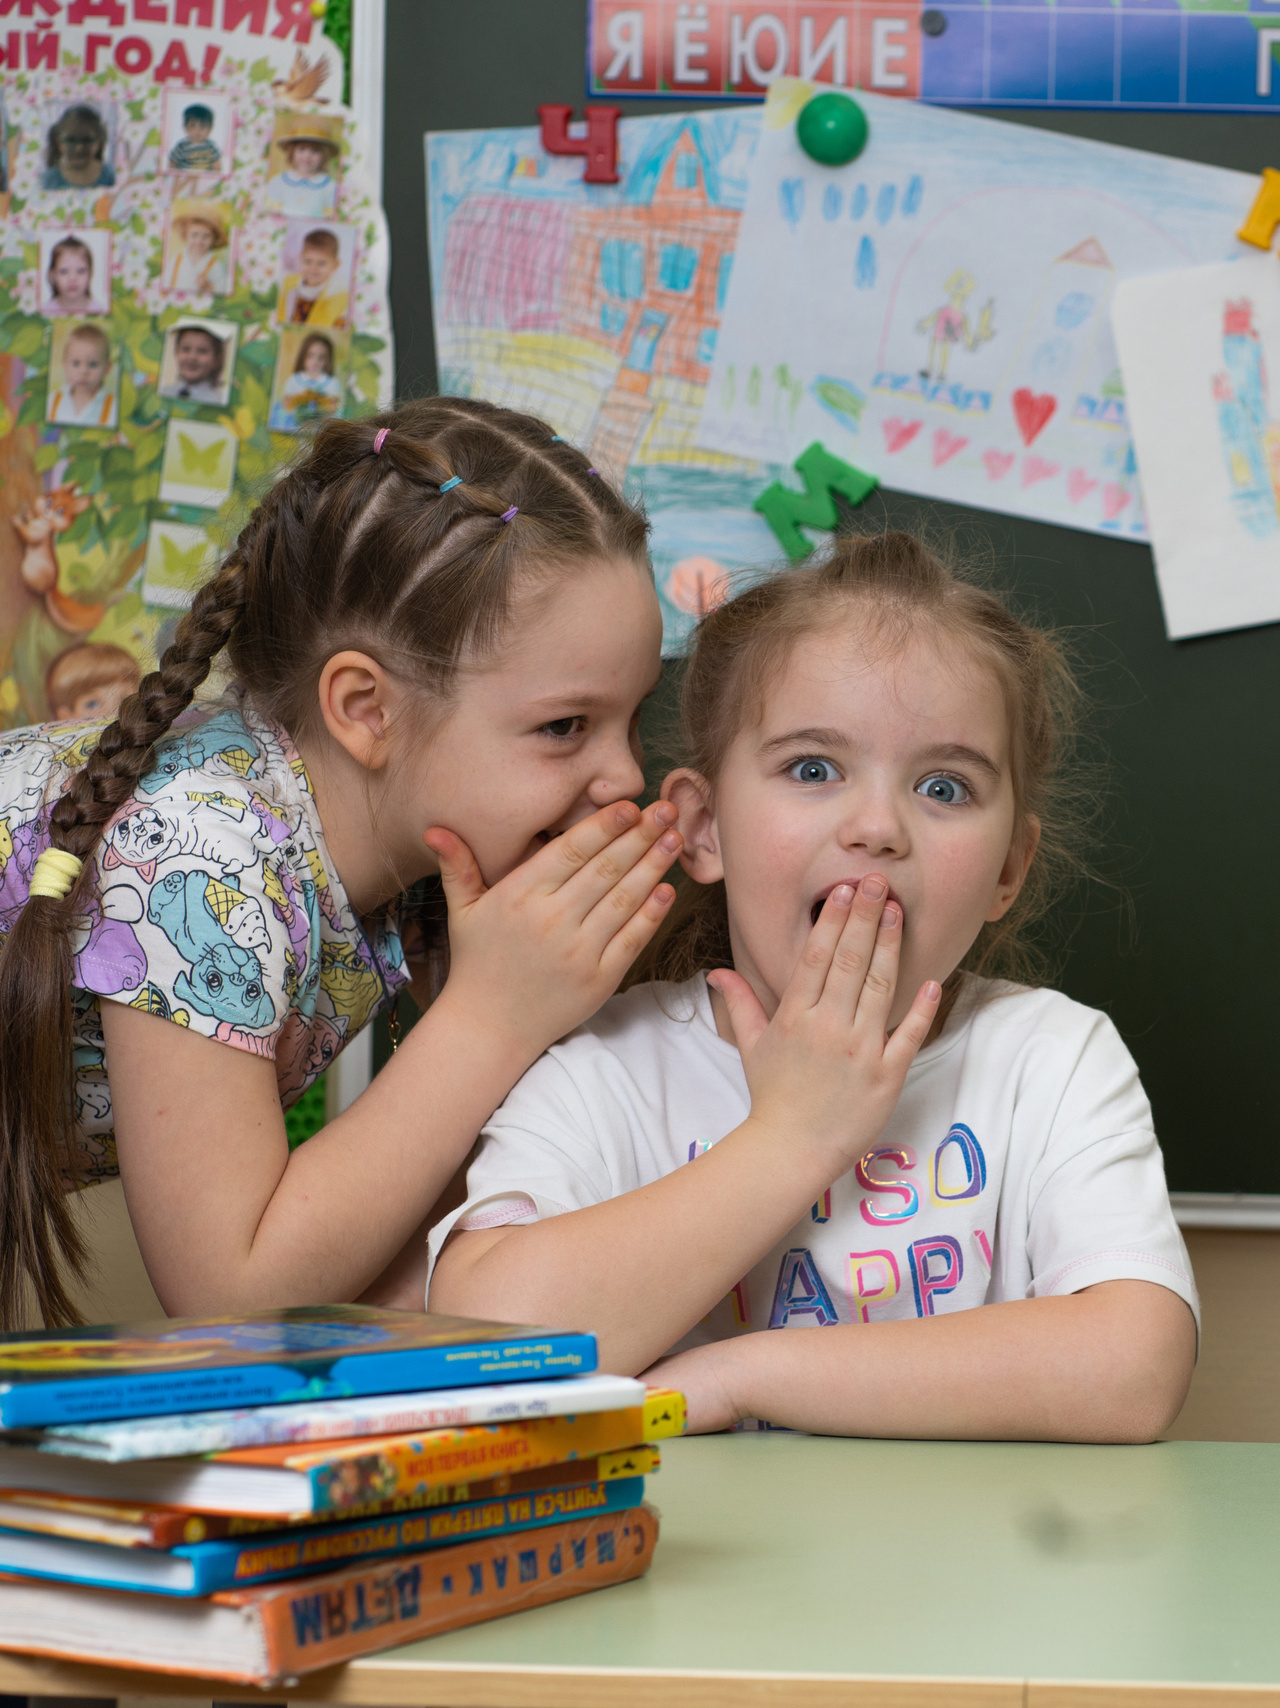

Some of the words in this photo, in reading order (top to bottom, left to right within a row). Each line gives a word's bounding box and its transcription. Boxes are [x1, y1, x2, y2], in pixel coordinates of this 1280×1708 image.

[0, 0, 316, 45] ДЕНИЯ
[85, 33, 224, 86] ГОД!
[701, 1229, 993, 1331] APP
[467, 1528, 616, 1596] МАРШАК
[290, 1564, 423, 1647] ДЕТЯМ
